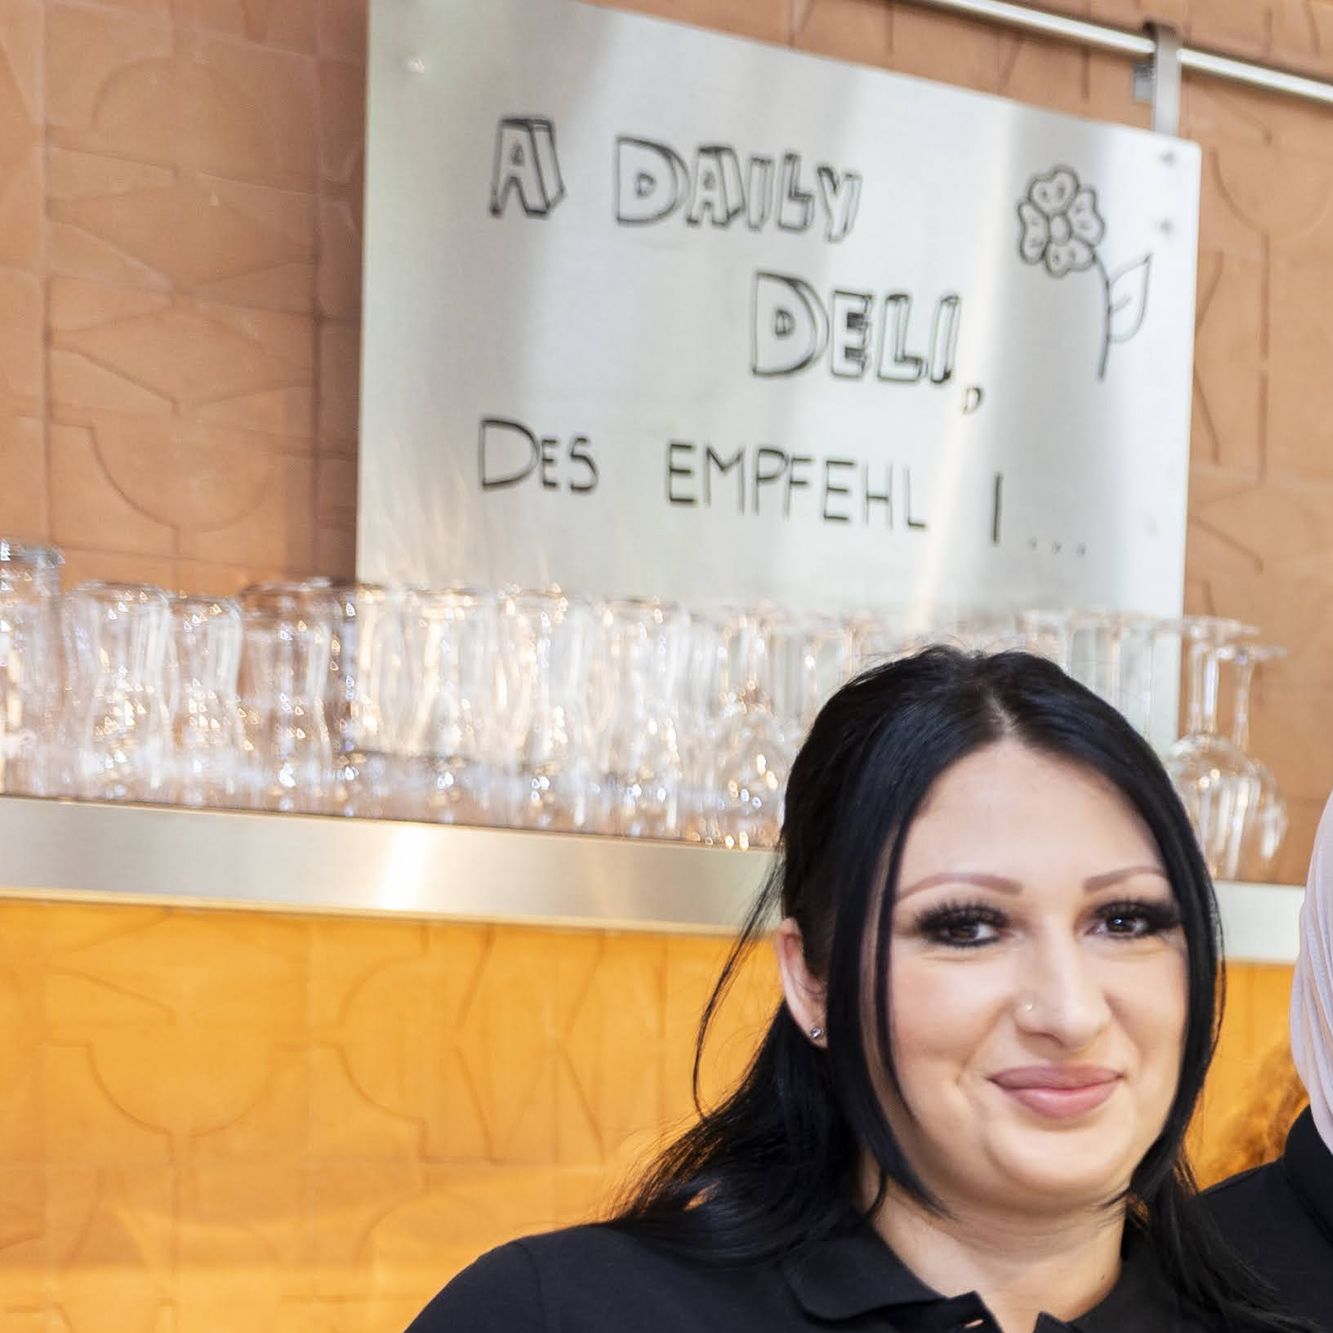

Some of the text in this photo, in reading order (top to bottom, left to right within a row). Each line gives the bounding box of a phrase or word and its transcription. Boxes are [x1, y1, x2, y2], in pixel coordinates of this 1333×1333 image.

[490, 116, 863, 242] A DAILY
[751, 270, 985, 415] DELI,
[479, 417, 599, 493] DES
[666, 440, 928, 532] EMPFEHL
